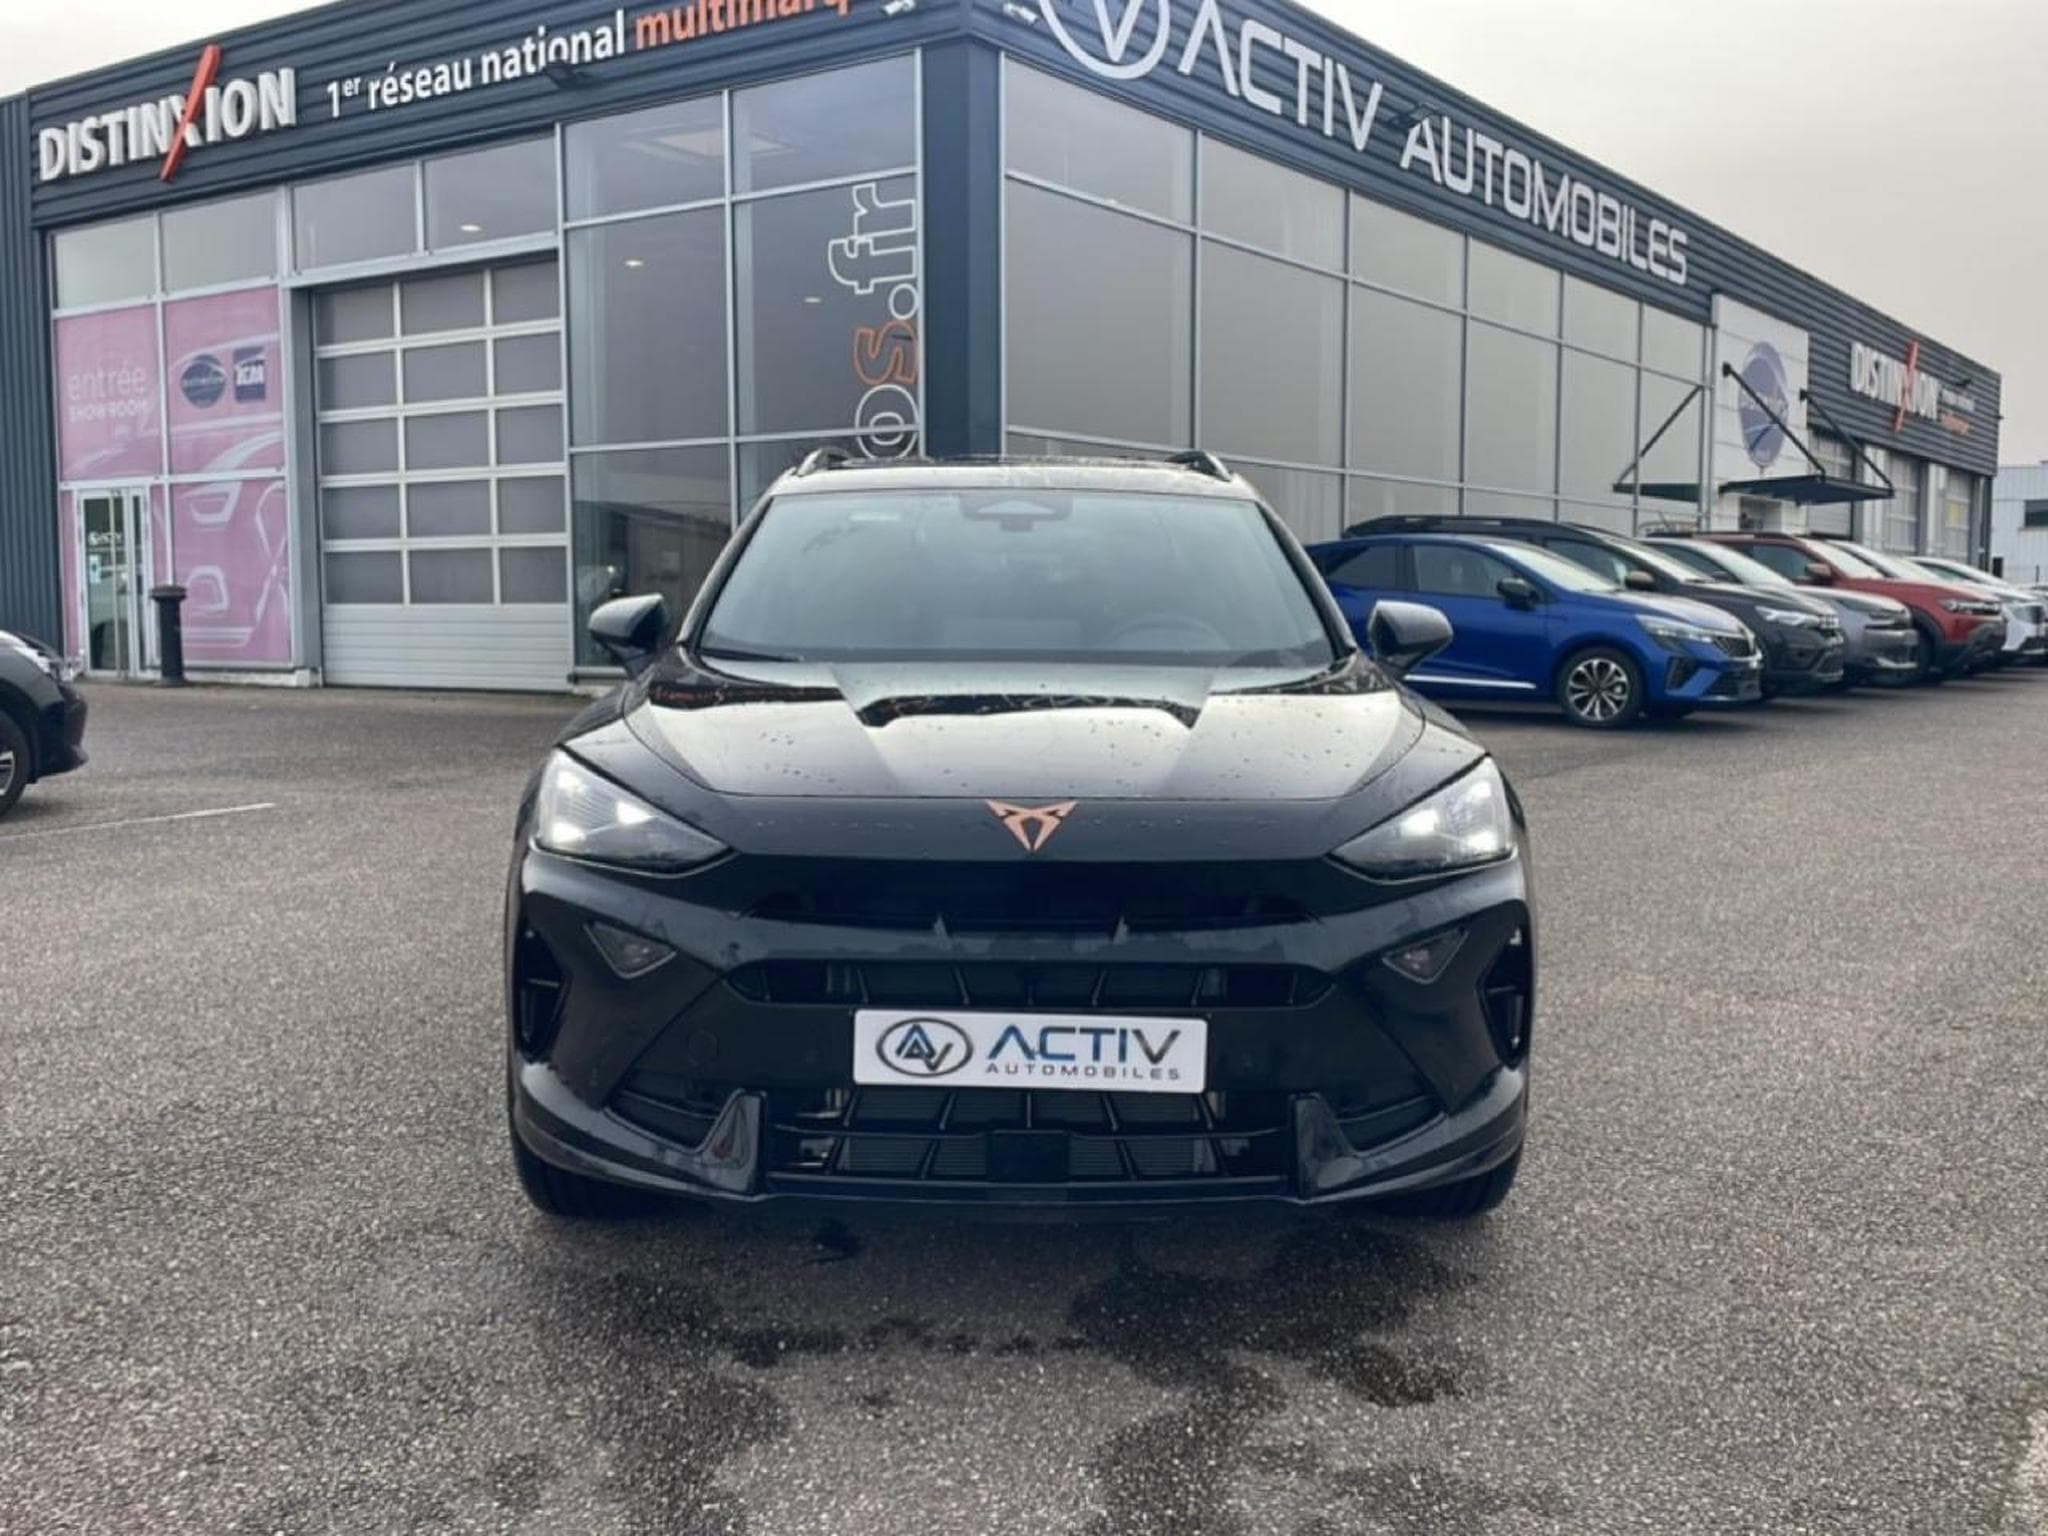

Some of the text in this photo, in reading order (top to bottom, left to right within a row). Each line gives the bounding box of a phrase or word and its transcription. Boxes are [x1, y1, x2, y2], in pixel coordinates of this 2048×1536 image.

[367, 62, 472, 110] réseau
[481, 11, 625, 85] national
[38, 43, 297, 184] DISTINXION
[1177, 0, 1688, 286] ACTIV AUTOMOBILES
[67, 361, 148, 400] entrée
[985, 1062, 1181, 1081] AUTOMOBILES
[987, 1024, 1181, 1065] ACTIV
